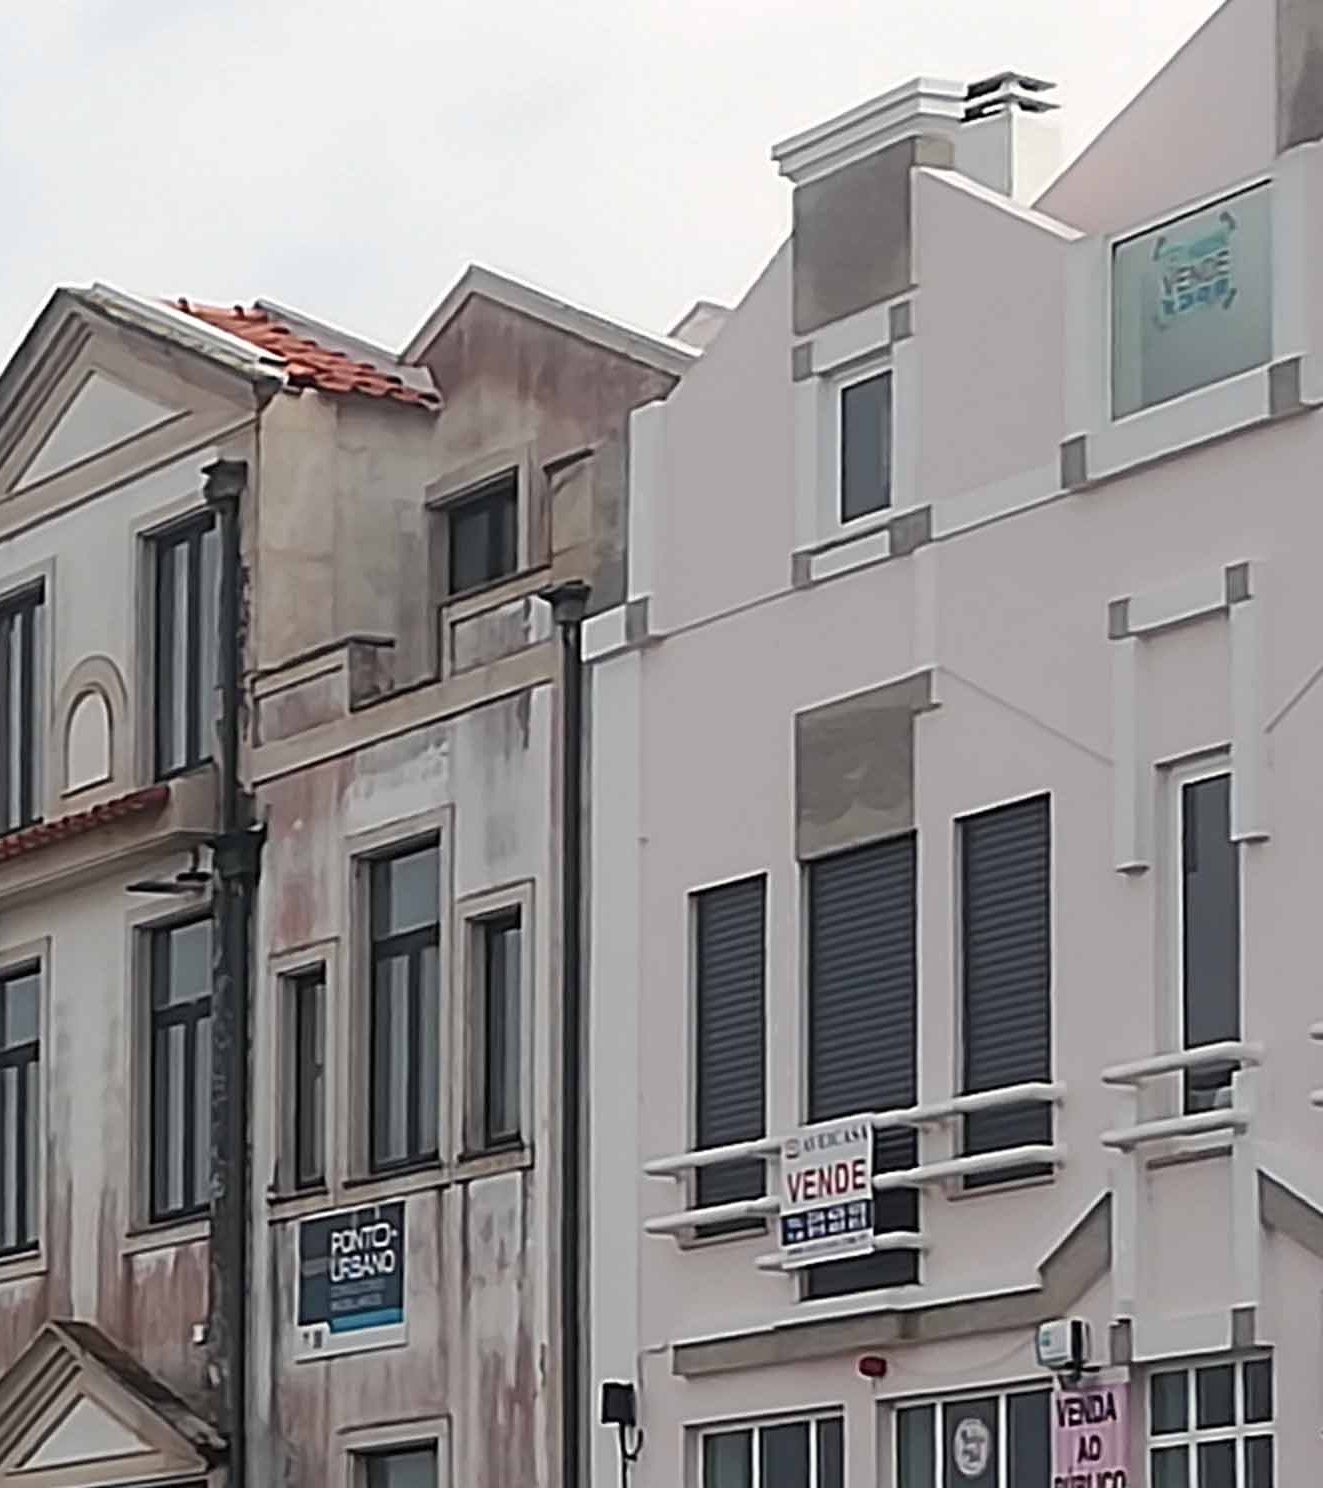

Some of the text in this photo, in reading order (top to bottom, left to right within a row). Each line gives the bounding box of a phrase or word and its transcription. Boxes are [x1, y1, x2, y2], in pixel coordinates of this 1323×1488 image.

[788, 1159, 866, 1203] VENDE
[1057, 1392, 1116, 1427] VENDA
[1078, 1435, 1102, 1463] AO
